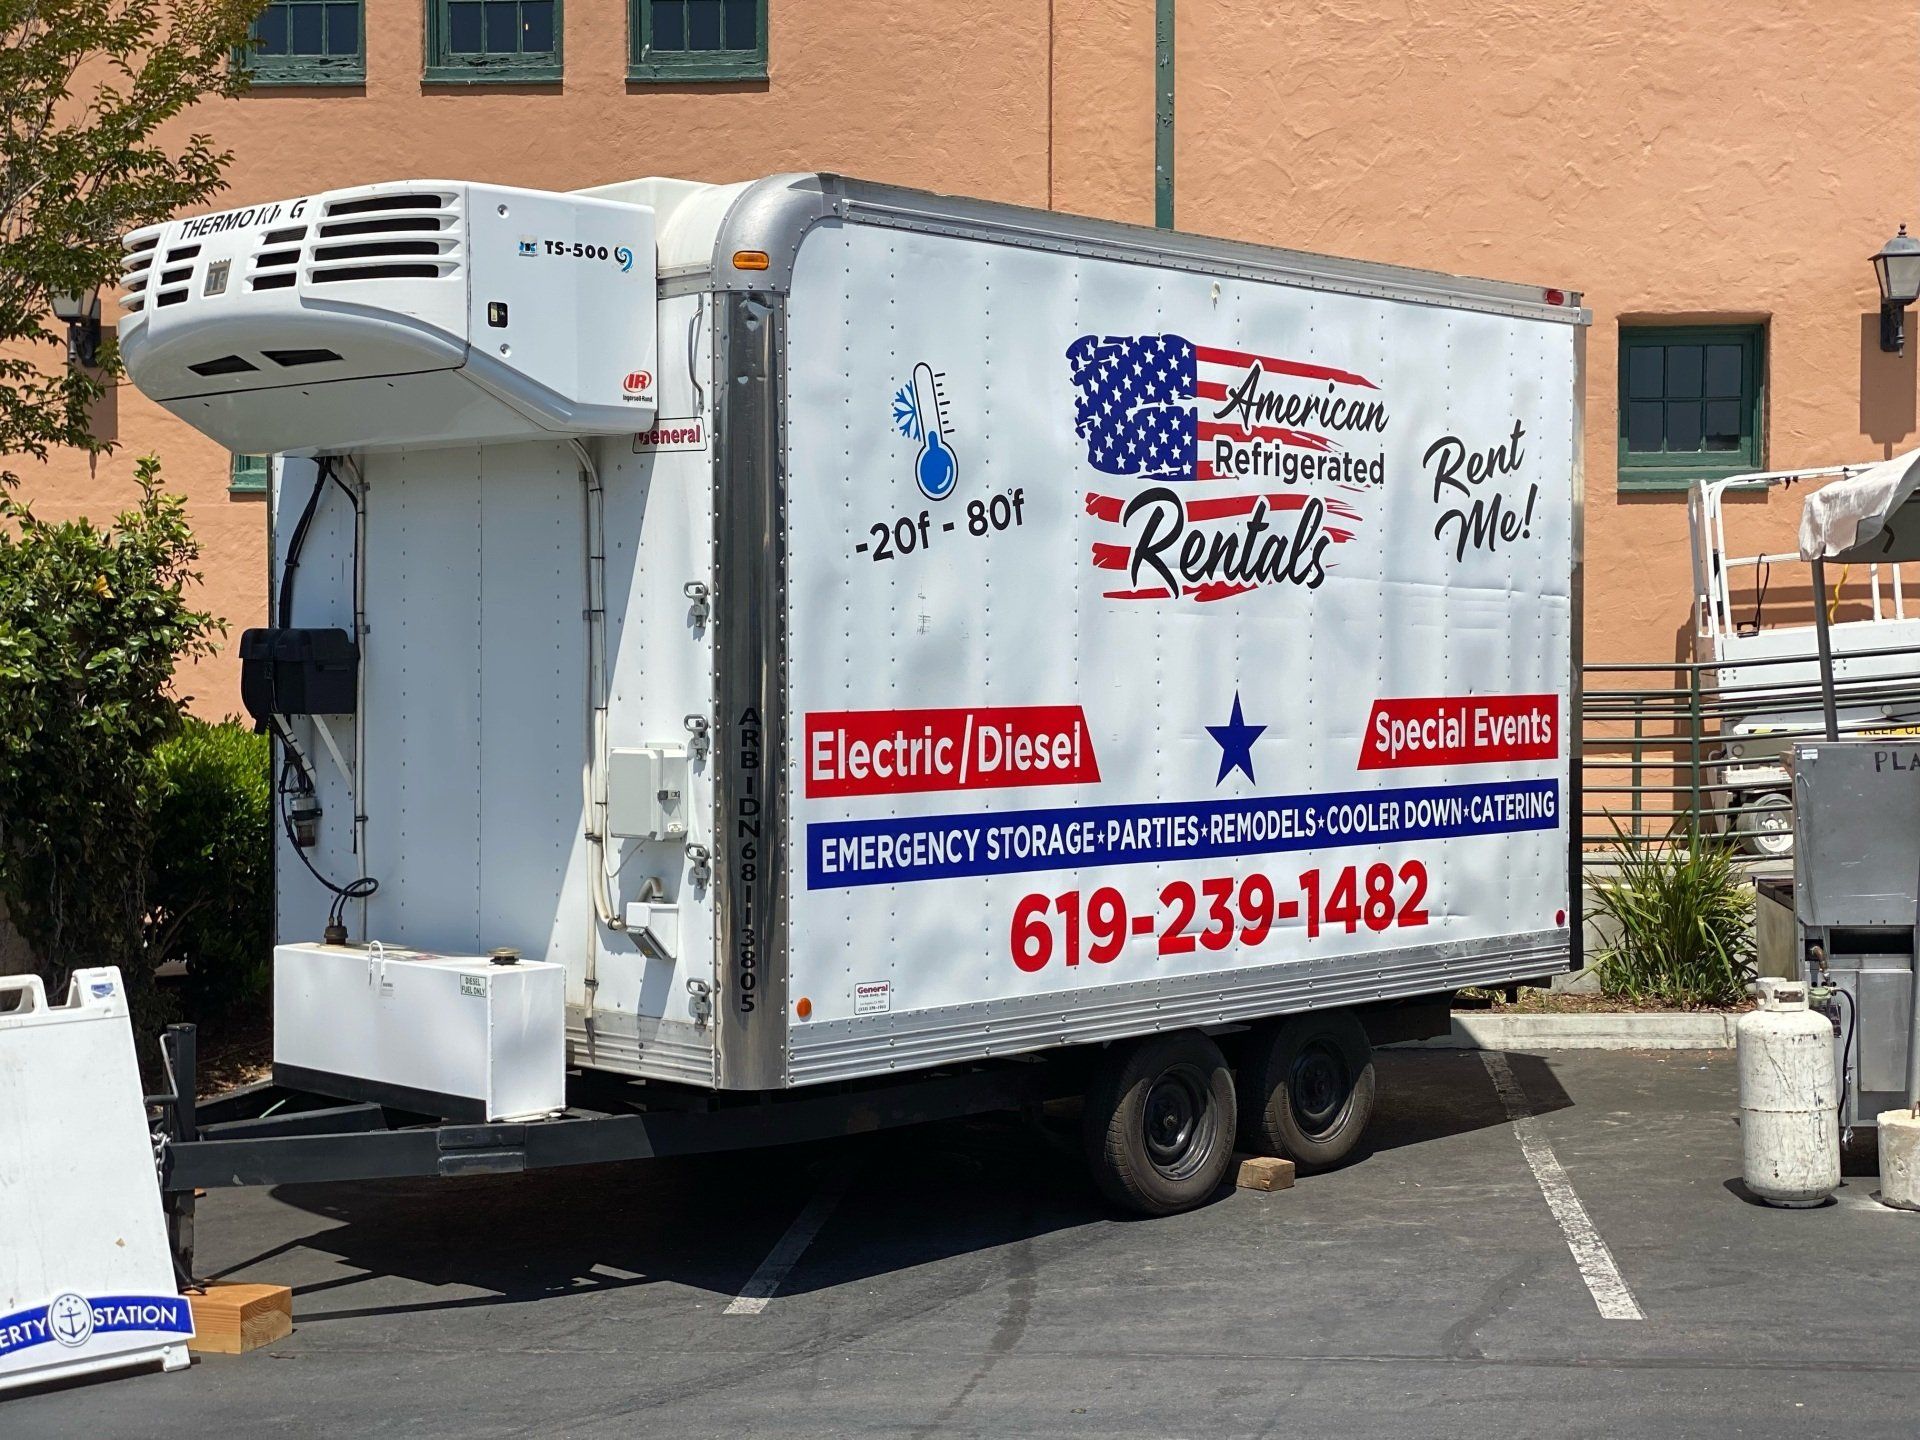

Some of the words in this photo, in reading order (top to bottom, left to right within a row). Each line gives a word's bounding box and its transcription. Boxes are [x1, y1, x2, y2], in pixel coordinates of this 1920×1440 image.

[180, 209, 256, 240] THERMO
[544, 240, 609, 260] TS-500
[627, 373, 647, 389] IR
[1213, 363, 1390, 433] American
[1215, 439, 1385, 485] Refrigerated
[1422, 419, 1526, 498] Rent
[855, 510, 931, 562] -20f
[1122, 487, 1330, 600] Rentals
[1434, 482, 1538, 562] Me!
[1375, 708, 1466, 750] Special
[1474, 707, 1551, 746] Events
[822, 833, 979, 874] EMERGENCY
[986, 821, 1095, 861] STORAGE
[1107, 815, 1199, 850] PARTIES
[1210, 807, 1316, 845] REMODELS
[1327, 802, 1400, 835] COOLER
[1405, 798, 1462, 829] DOWN
[1470, 791, 1555, 824] CATERING
[1009, 859, 1429, 973] 619-239-1482
[857, 984, 888, 994] General
[93, 1305, 177, 1326] STATION
